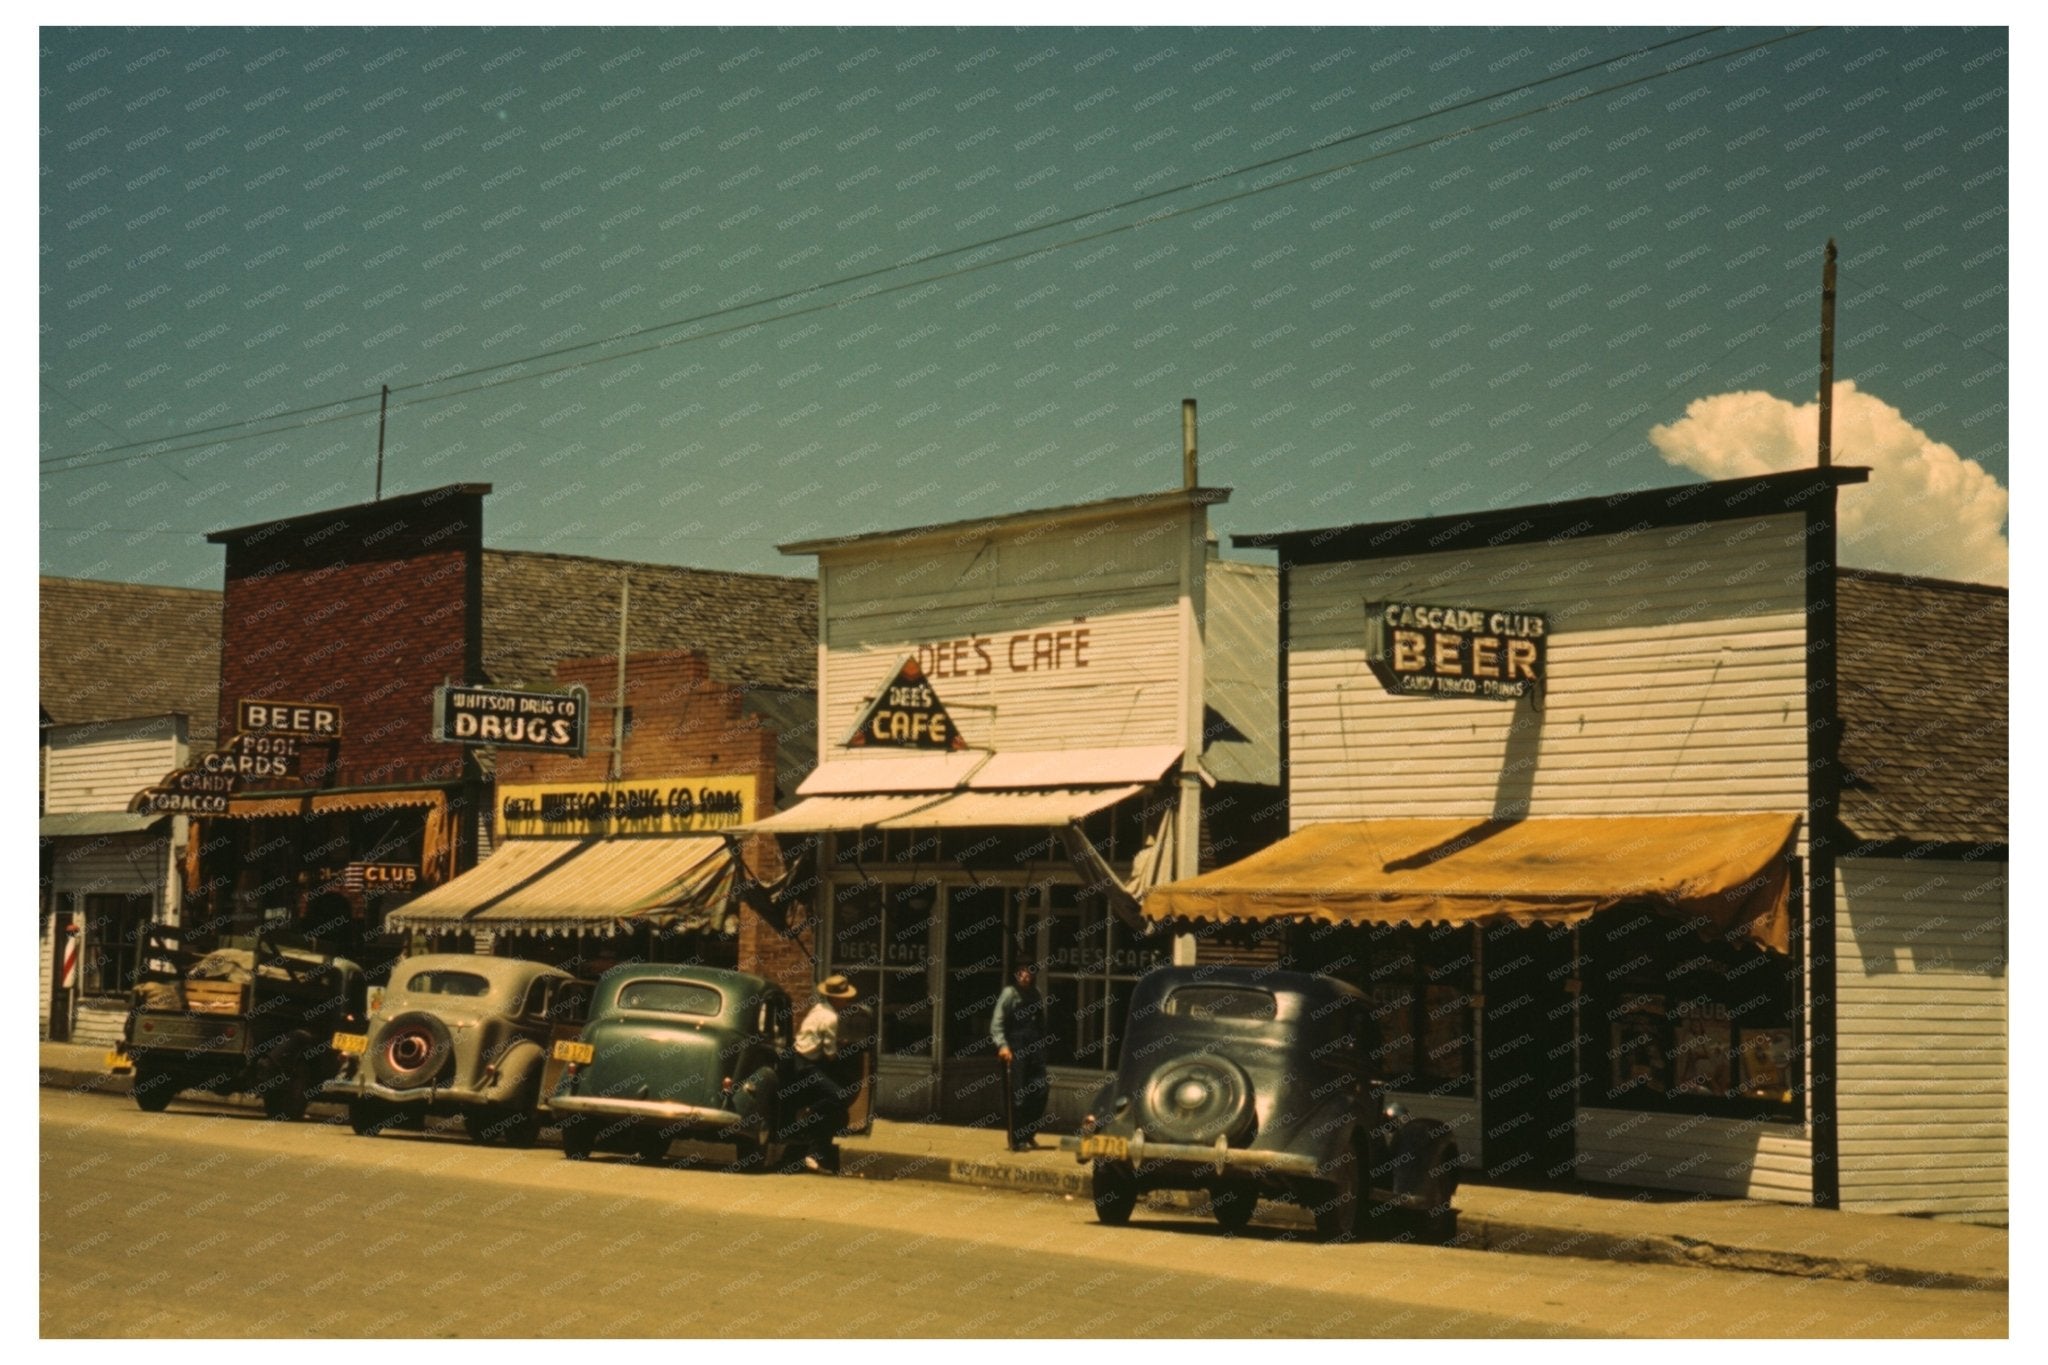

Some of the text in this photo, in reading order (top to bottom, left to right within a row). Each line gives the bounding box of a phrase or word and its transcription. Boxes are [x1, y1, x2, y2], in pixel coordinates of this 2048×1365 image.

[1386, 606, 1544, 638] CASCADE CLUB
[1394, 630, 1537, 680] BEER
[453, 693, 515, 712] WHITSON
[520, 698, 554, 714] DRUG
[890, 684, 932, 708] DEE'S
[248, 705, 334, 732] BEER
[456, 713, 570, 744] DRUGS
[873, 711, 947, 742] CAFE
[243, 737, 299, 756] POOL
[204, 753, 287, 776] CARDS
[180, 773, 235, 792] CANDY
[149, 793, 226, 812] TOBACCO
[365, 866, 417, 881] CLUB
